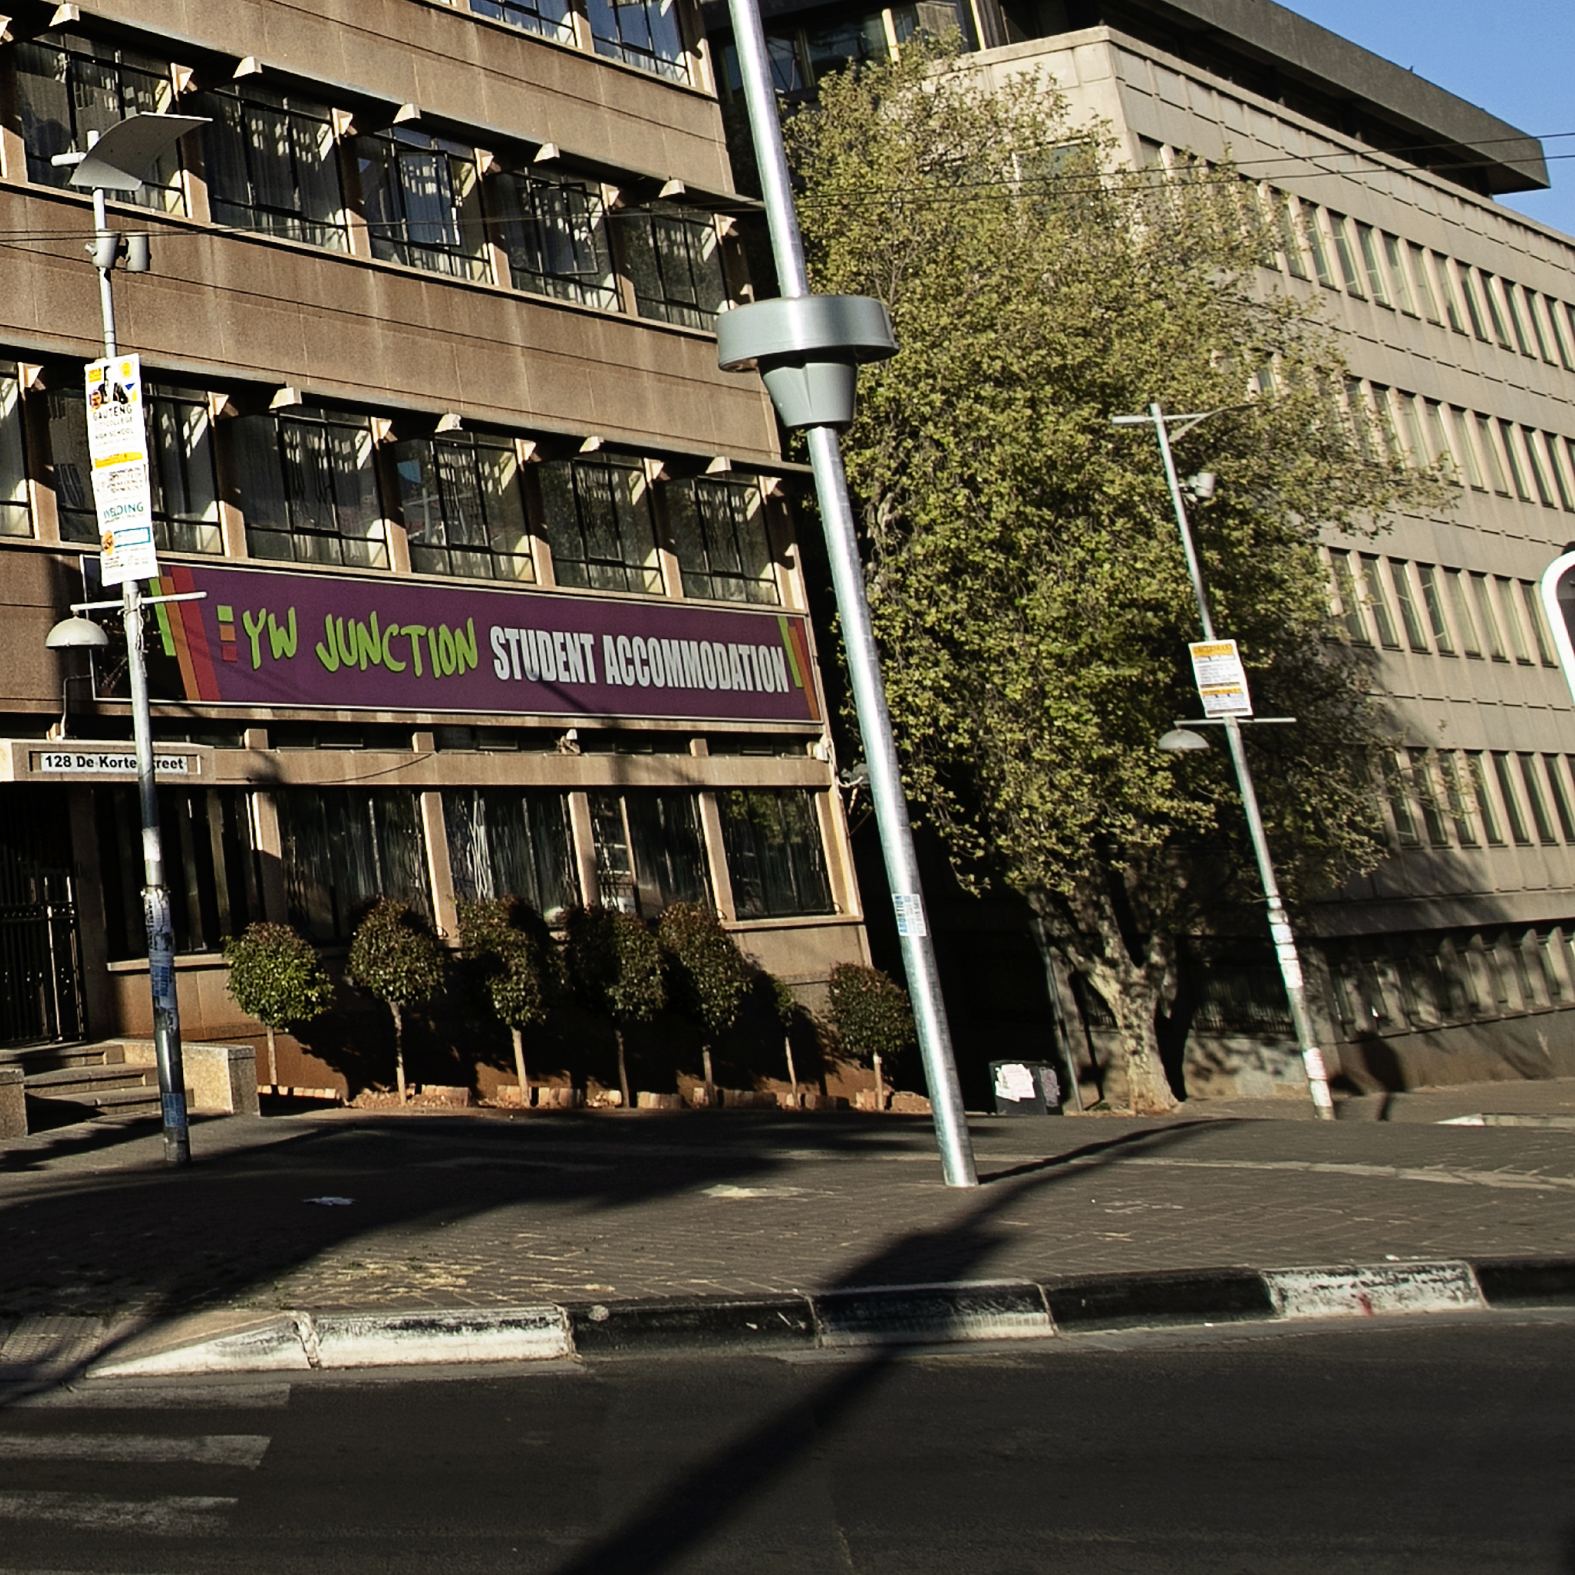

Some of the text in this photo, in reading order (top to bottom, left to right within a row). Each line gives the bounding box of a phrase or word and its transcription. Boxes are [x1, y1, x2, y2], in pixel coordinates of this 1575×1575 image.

[242, 606, 789, 693] YW JUNCTION STUDENT ACCOMMODATION
[45, 754, 72, 768] 128
[76, 755, 94, 768] De
[99, 756, 137, 769] Korte
